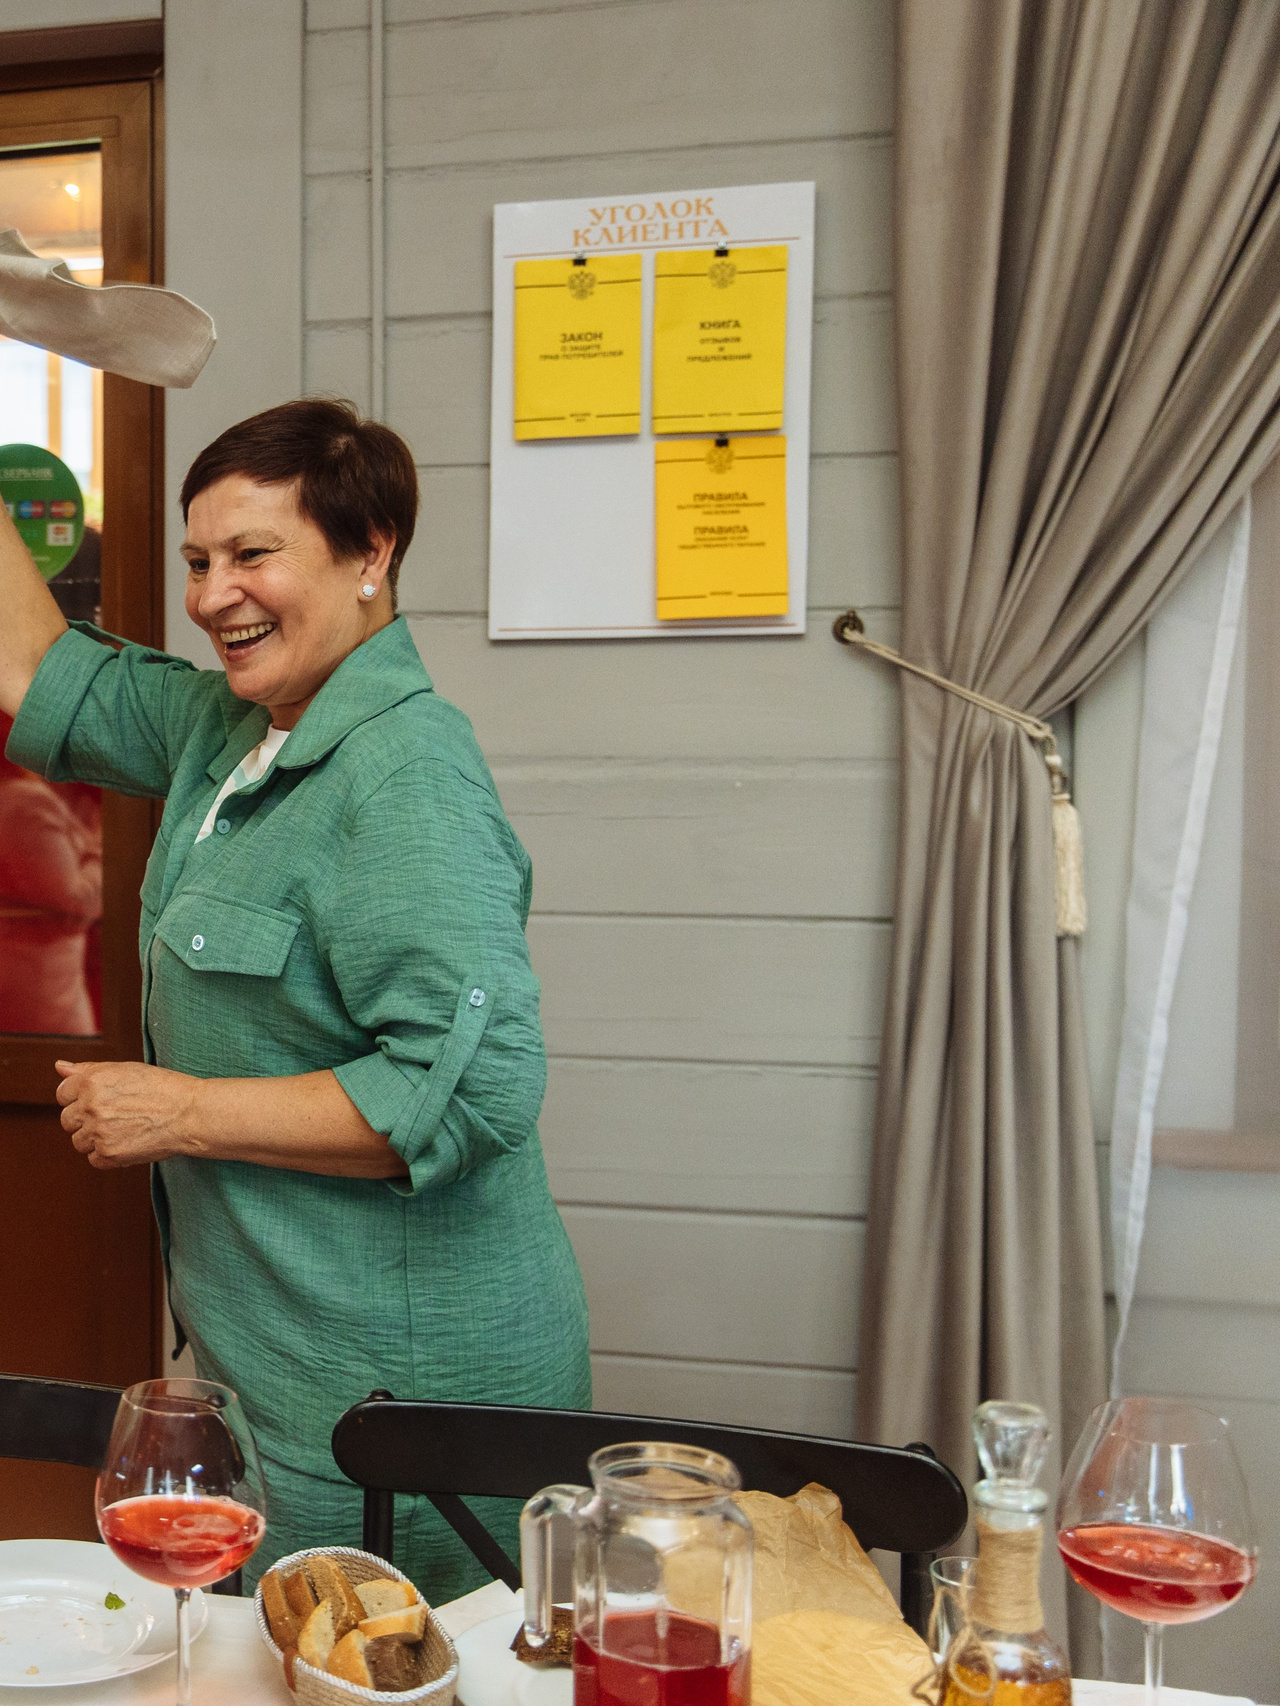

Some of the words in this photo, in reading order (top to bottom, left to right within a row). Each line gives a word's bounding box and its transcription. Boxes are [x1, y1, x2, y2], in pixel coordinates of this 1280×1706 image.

[588, 197, 714, 226] УГОЛОК
[573, 218, 729, 247] КЛИЕНТА
[699, 319, 741, 330] КНИГА
[560, 332, 603, 343] ЗАКОН
